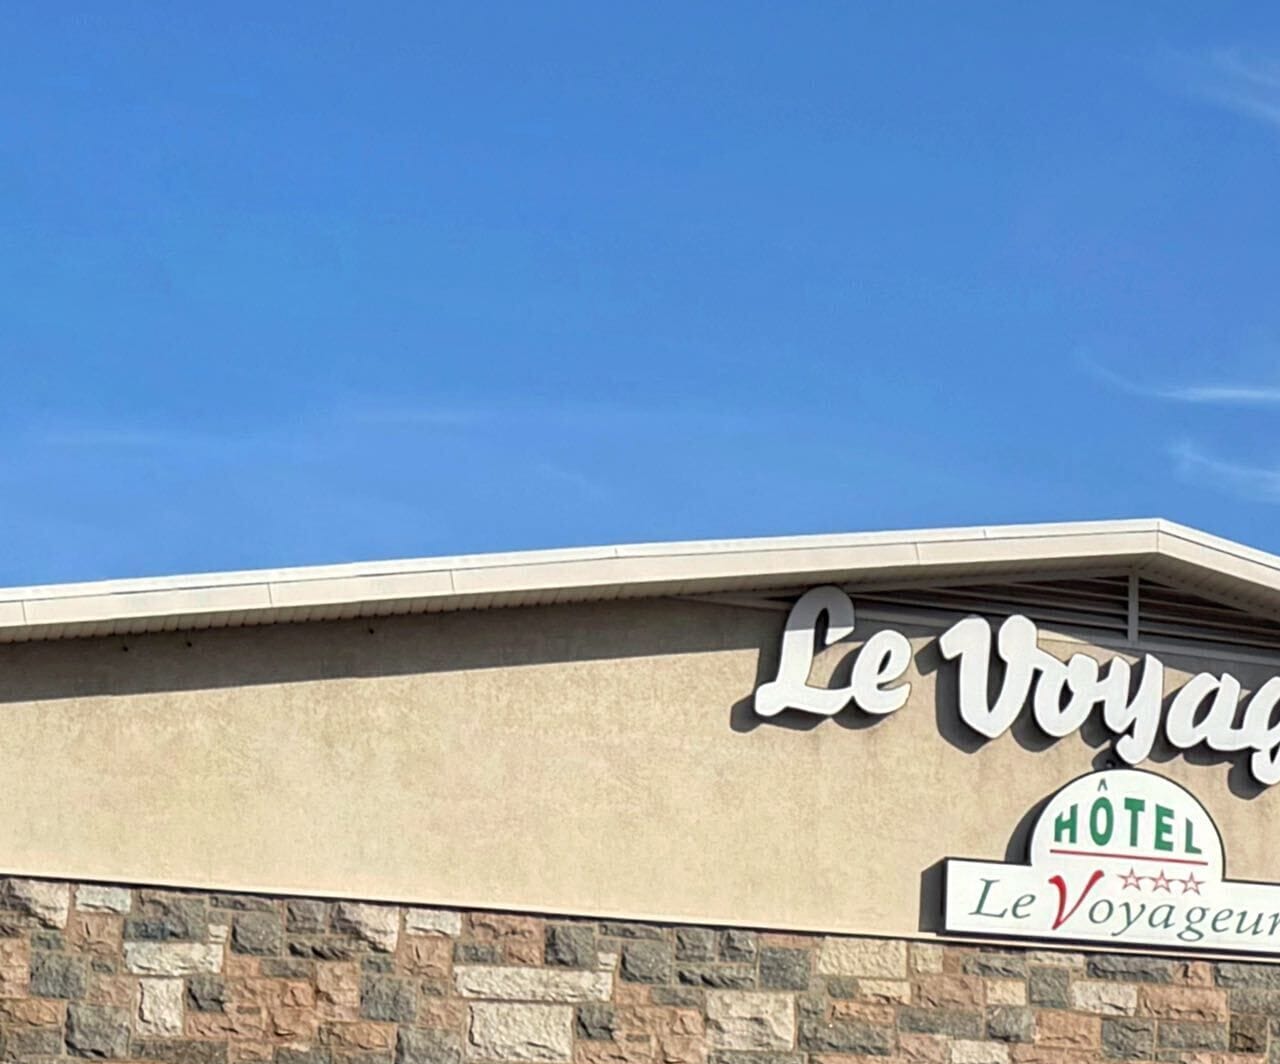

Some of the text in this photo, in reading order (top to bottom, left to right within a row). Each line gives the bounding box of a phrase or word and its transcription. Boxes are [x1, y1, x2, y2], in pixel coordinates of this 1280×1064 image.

[754, 585, 912, 718] Le
[1053, 778, 1202, 855] HÔTEL
[968, 878, 1037, 919] Le
